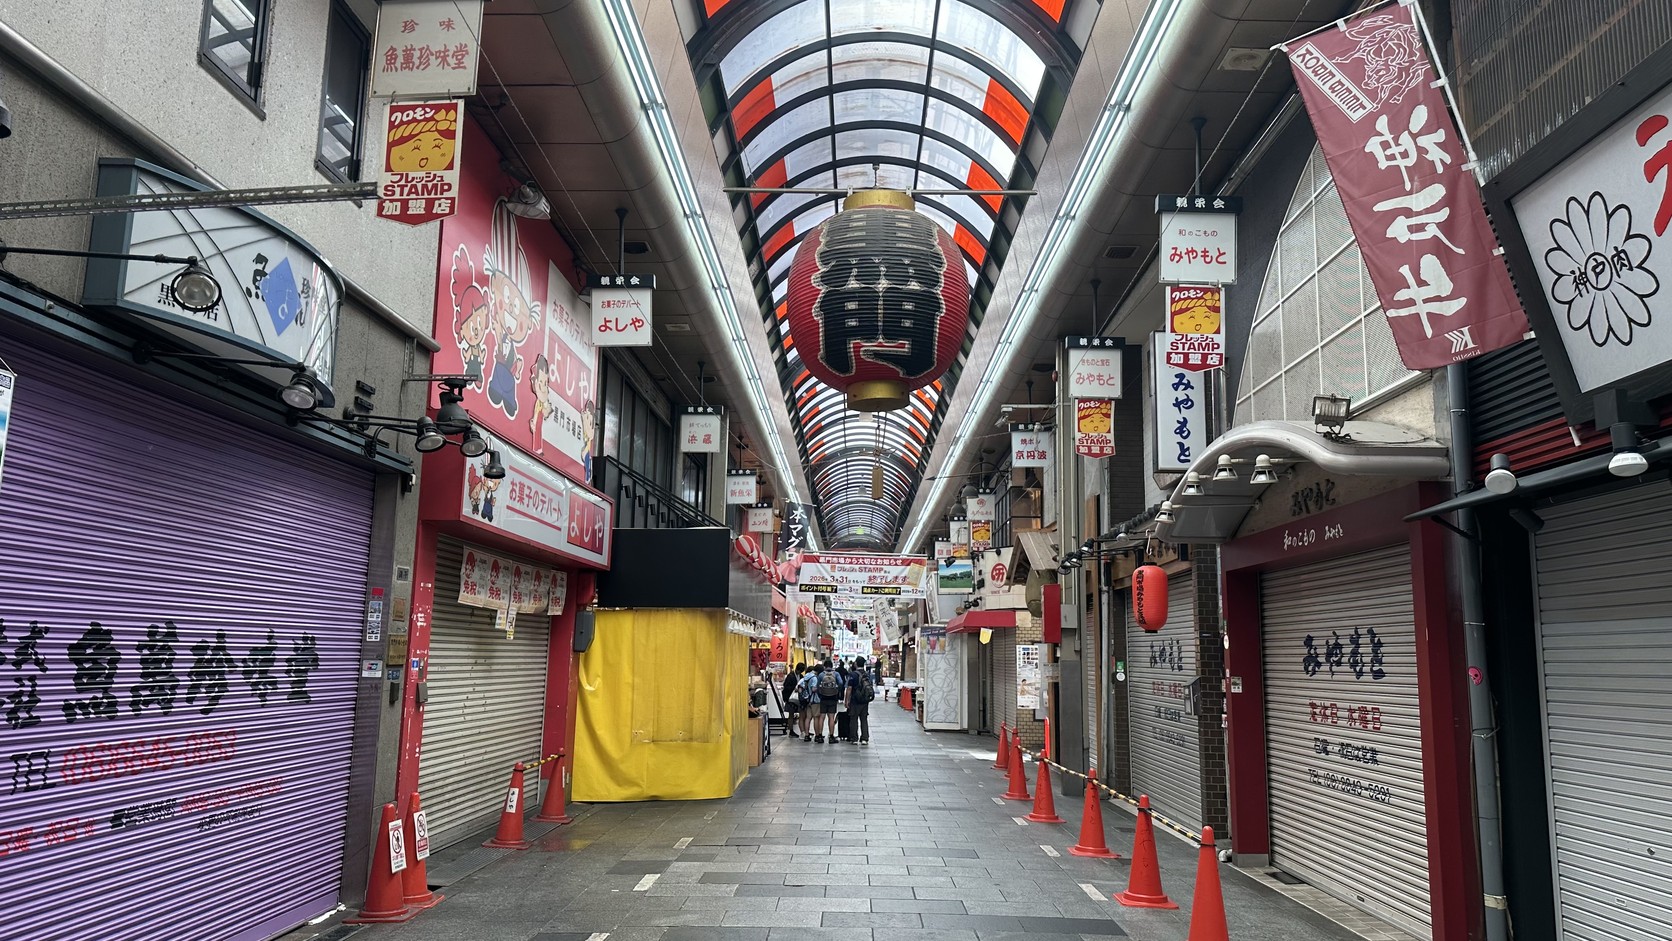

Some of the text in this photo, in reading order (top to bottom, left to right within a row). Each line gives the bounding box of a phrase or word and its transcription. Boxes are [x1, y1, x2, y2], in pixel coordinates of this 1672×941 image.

[382, 42, 469, 73] 魚萬珍味堂
[390, 107, 435, 125] クロモン
[390, 172, 445, 184] フレッシュ
[383, 183, 453, 197] STAMP
[382, 199, 451, 215] 加盟店
[1178, 229, 1218, 237] 和のこもの
[1169, 247, 1227, 264] みやもと
[1571, 246, 1635, 297] 神戸肉
[1172, 290, 1204, 301] クロモン
[598, 317, 645, 333] よしや
[1174, 334, 1215, 343] フレッシュ
[1170, 342, 1220, 351] STAMP
[1169, 353, 1220, 364] 加盟店
[549, 342, 589, 409] よしや
[1076, 373, 1115, 386] みやもと
[1079, 401, 1100, 409] クロモン
[1171, 372, 1194, 464] みやもと
[1078, 438, 1111, 446] STAMP
[1015, 450, 1047, 460] 京丹波
[509, 478, 562, 522] お菓子のデパート
[570, 501, 604, 548] よしや
[1303, 626, 1386, 681] みやもと
